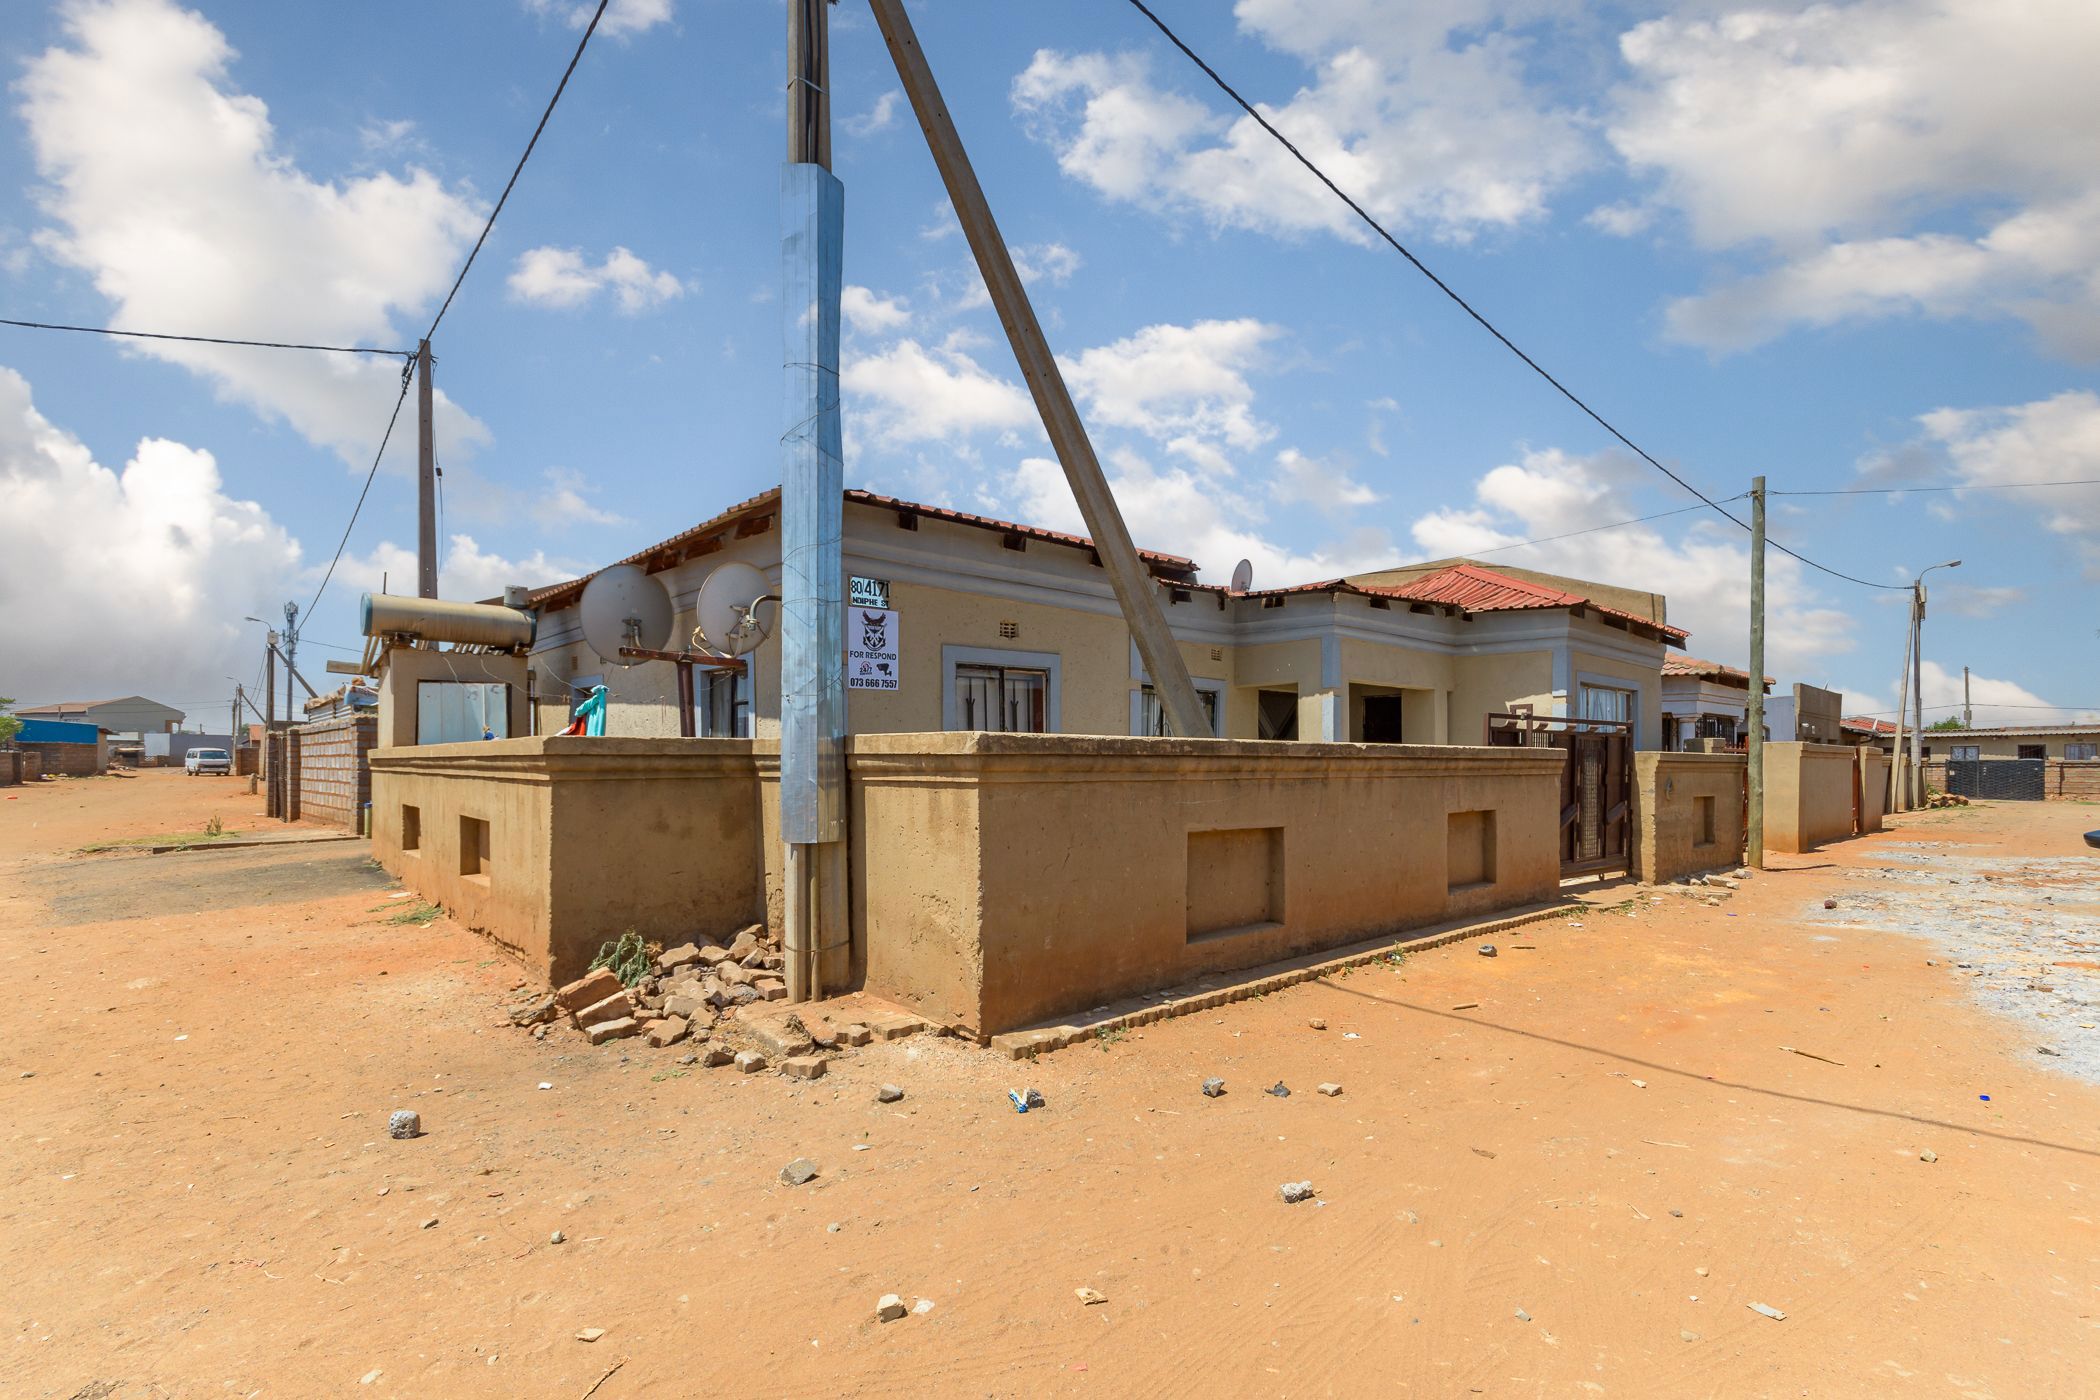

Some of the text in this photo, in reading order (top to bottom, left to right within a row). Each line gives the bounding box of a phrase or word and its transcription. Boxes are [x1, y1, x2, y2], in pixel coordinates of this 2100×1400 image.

[850, 651, 897, 660] FOR RESPOND
[850, 677, 897, 689] 073 666 7557
